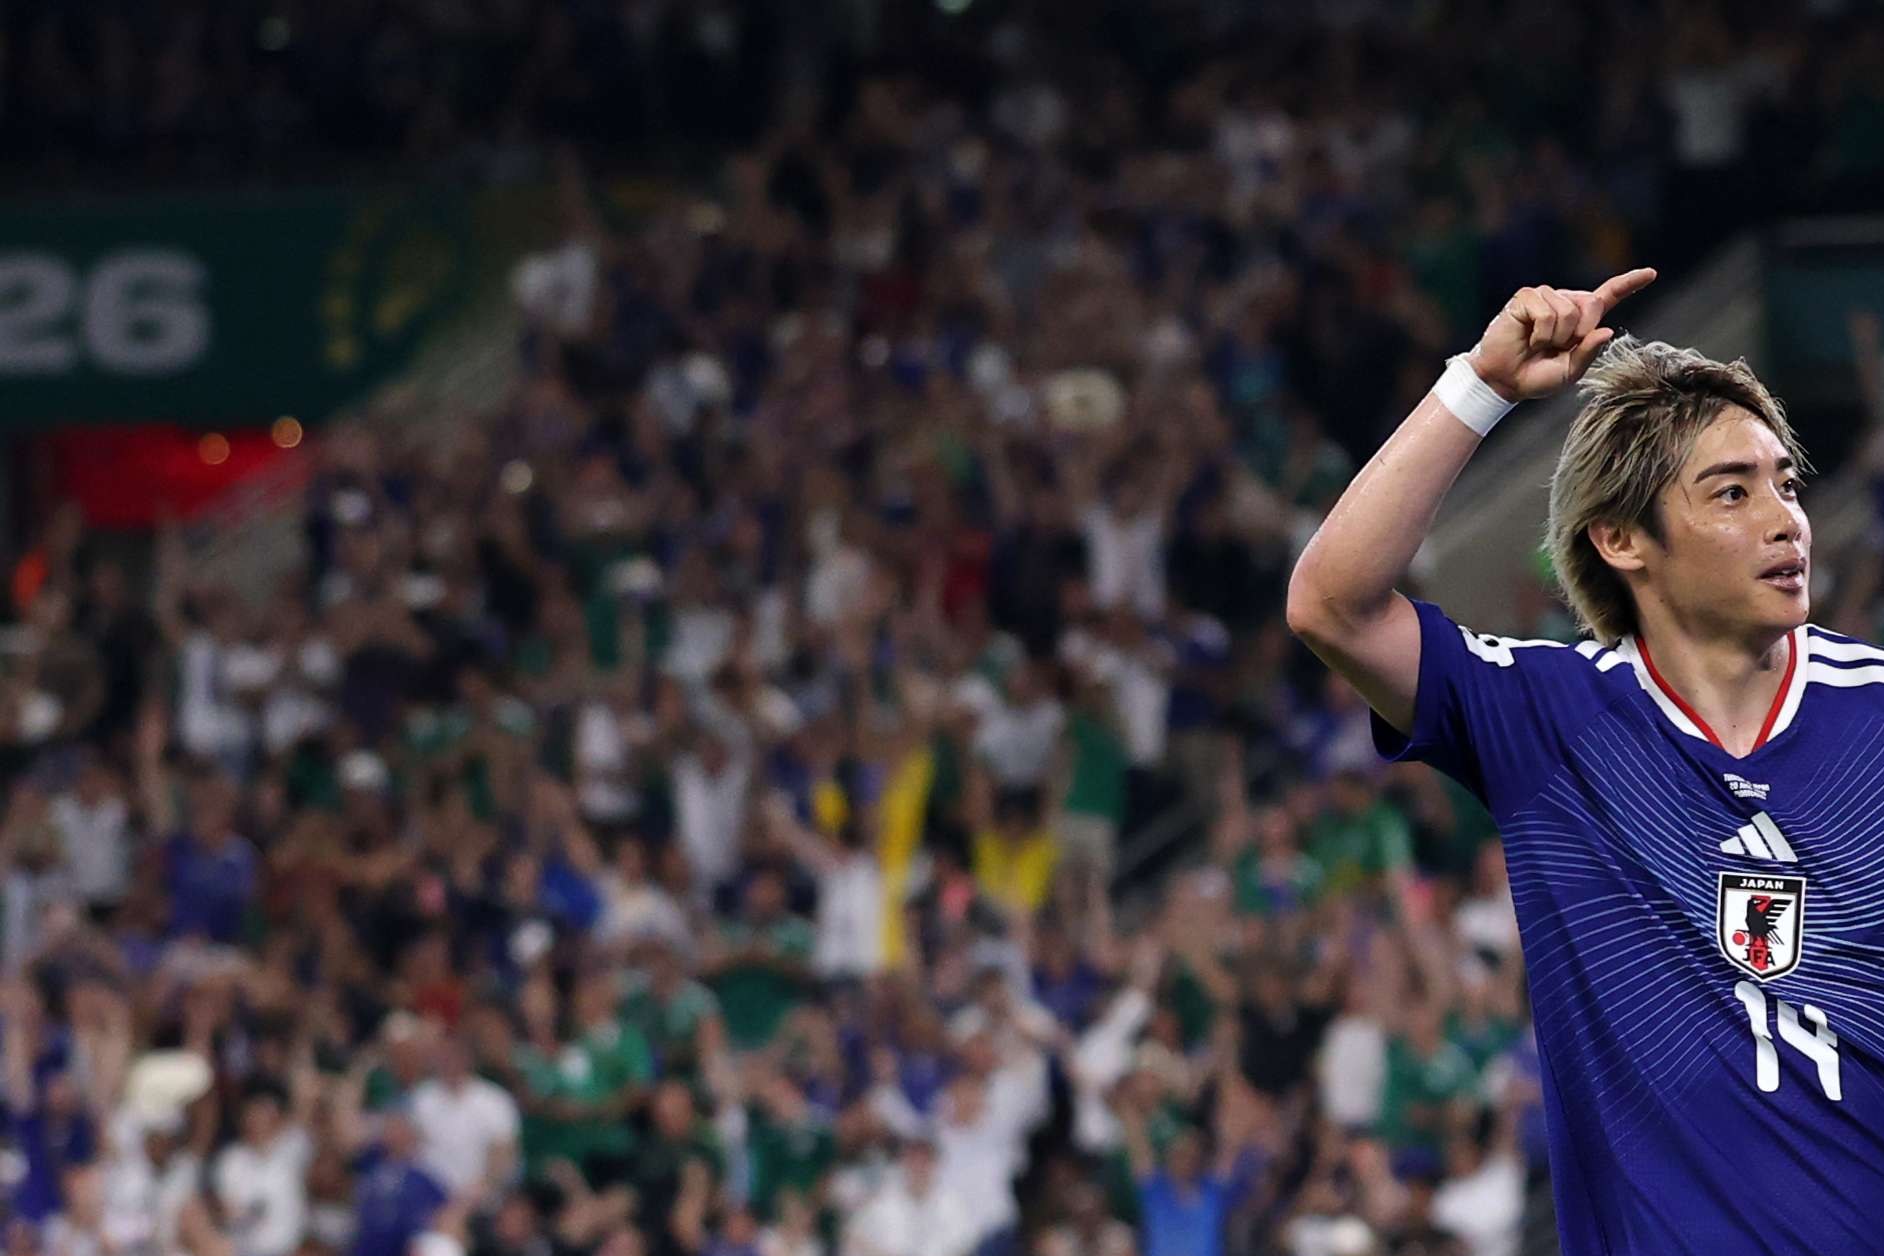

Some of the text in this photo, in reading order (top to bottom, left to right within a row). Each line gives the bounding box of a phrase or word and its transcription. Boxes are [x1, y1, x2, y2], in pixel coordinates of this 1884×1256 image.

[0, 248, 210, 375] 26
[1740, 879, 1784, 890] JAPAN
[1742, 945, 1776, 967] JFA
[1734, 981, 1843, 1101] 14
